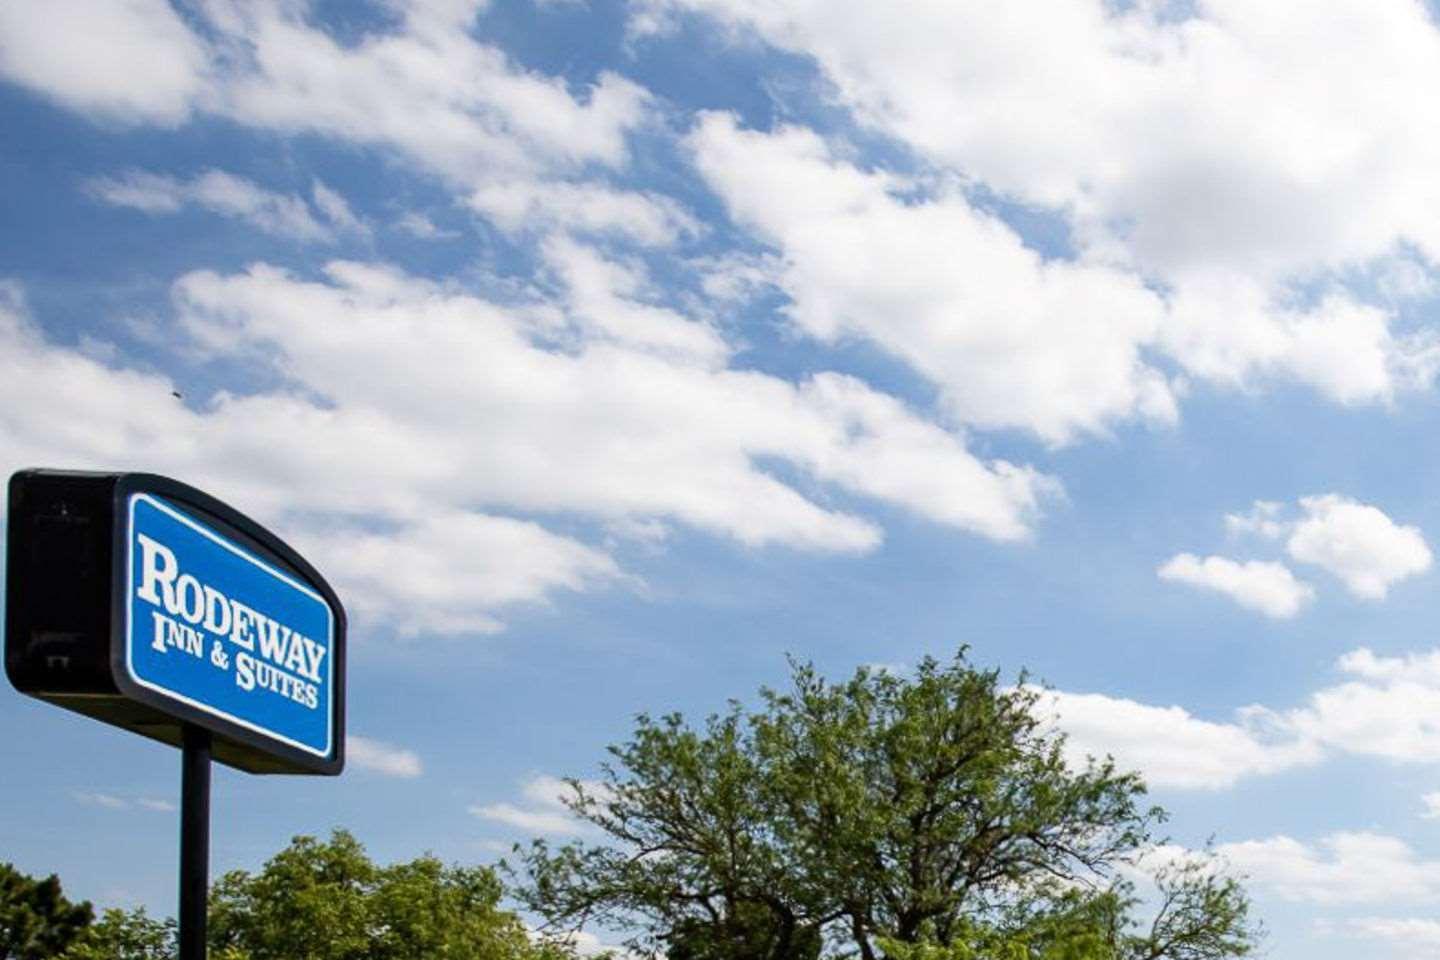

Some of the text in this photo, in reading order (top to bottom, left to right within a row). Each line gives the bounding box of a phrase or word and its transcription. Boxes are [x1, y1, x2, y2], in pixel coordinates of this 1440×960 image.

[137, 533, 326, 684] RODEWAY
[151, 611, 319, 710] INN & SUITES
